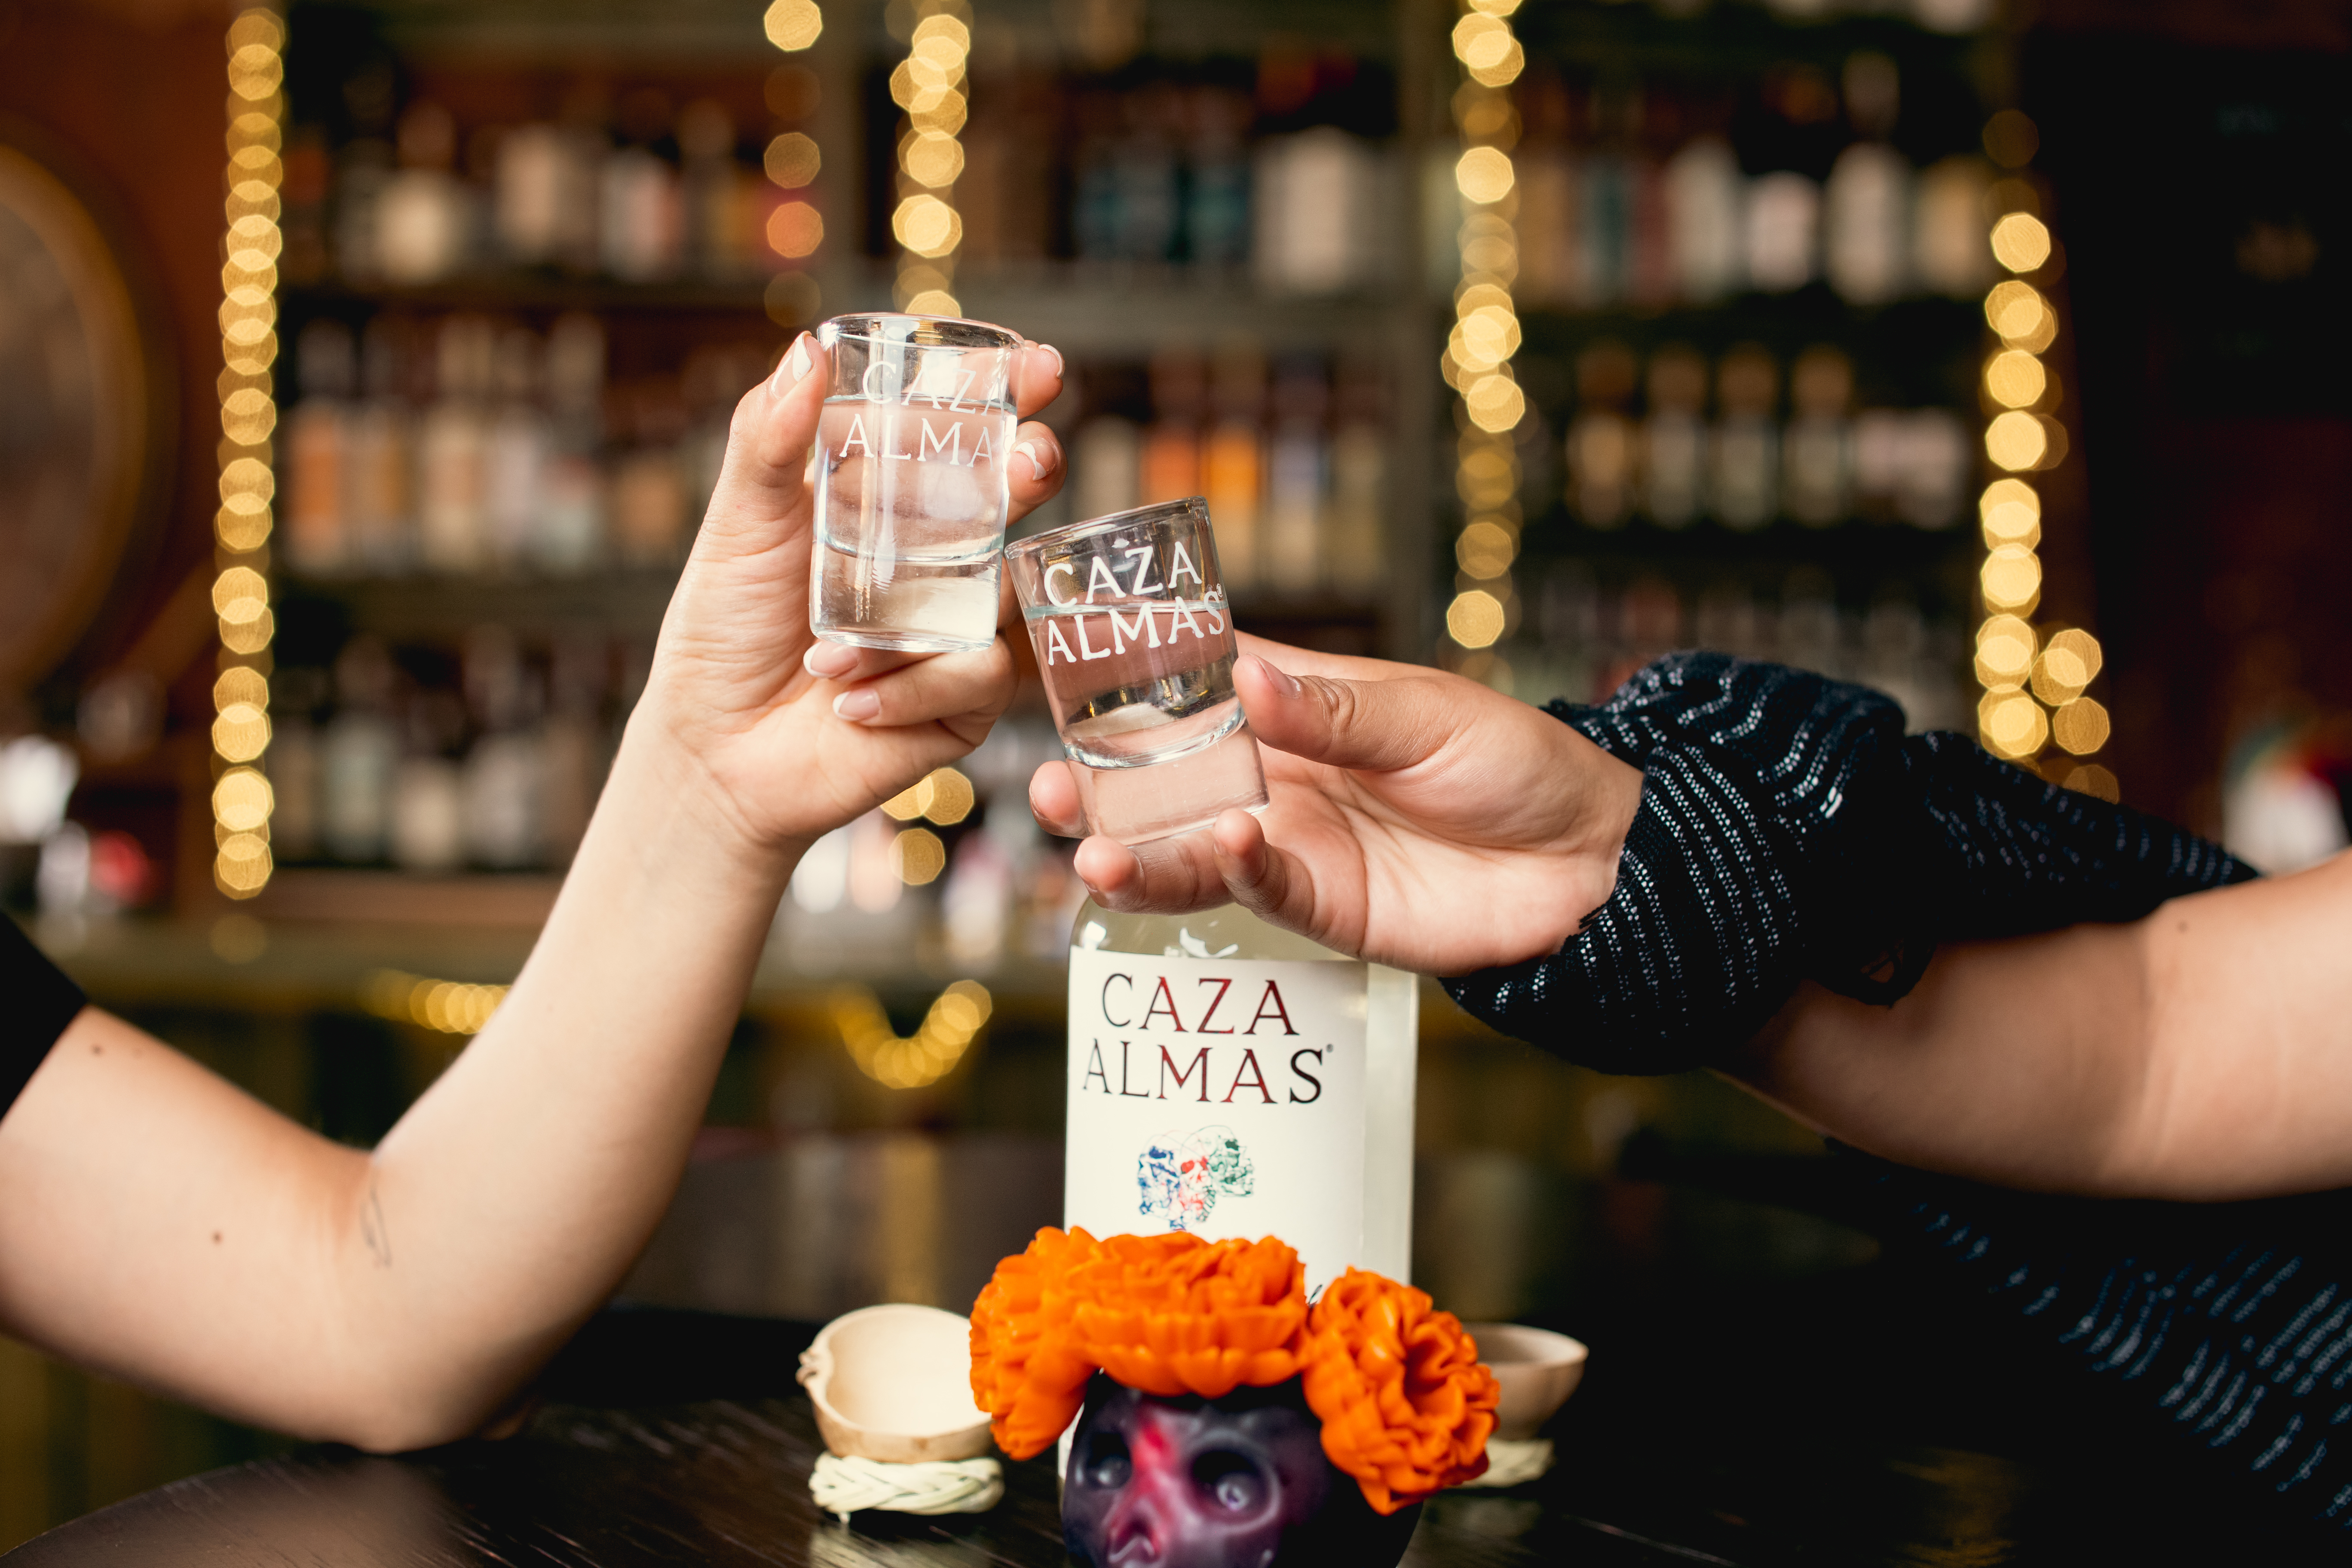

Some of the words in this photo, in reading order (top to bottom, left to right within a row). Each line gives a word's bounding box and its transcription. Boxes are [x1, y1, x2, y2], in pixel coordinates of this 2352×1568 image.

[862, 361, 1006, 421] CAZA
[839, 413, 1013, 474] ALMA
[1044, 541, 1202, 609] CAZA
[1102, 973, 1300, 1036] CAZA
